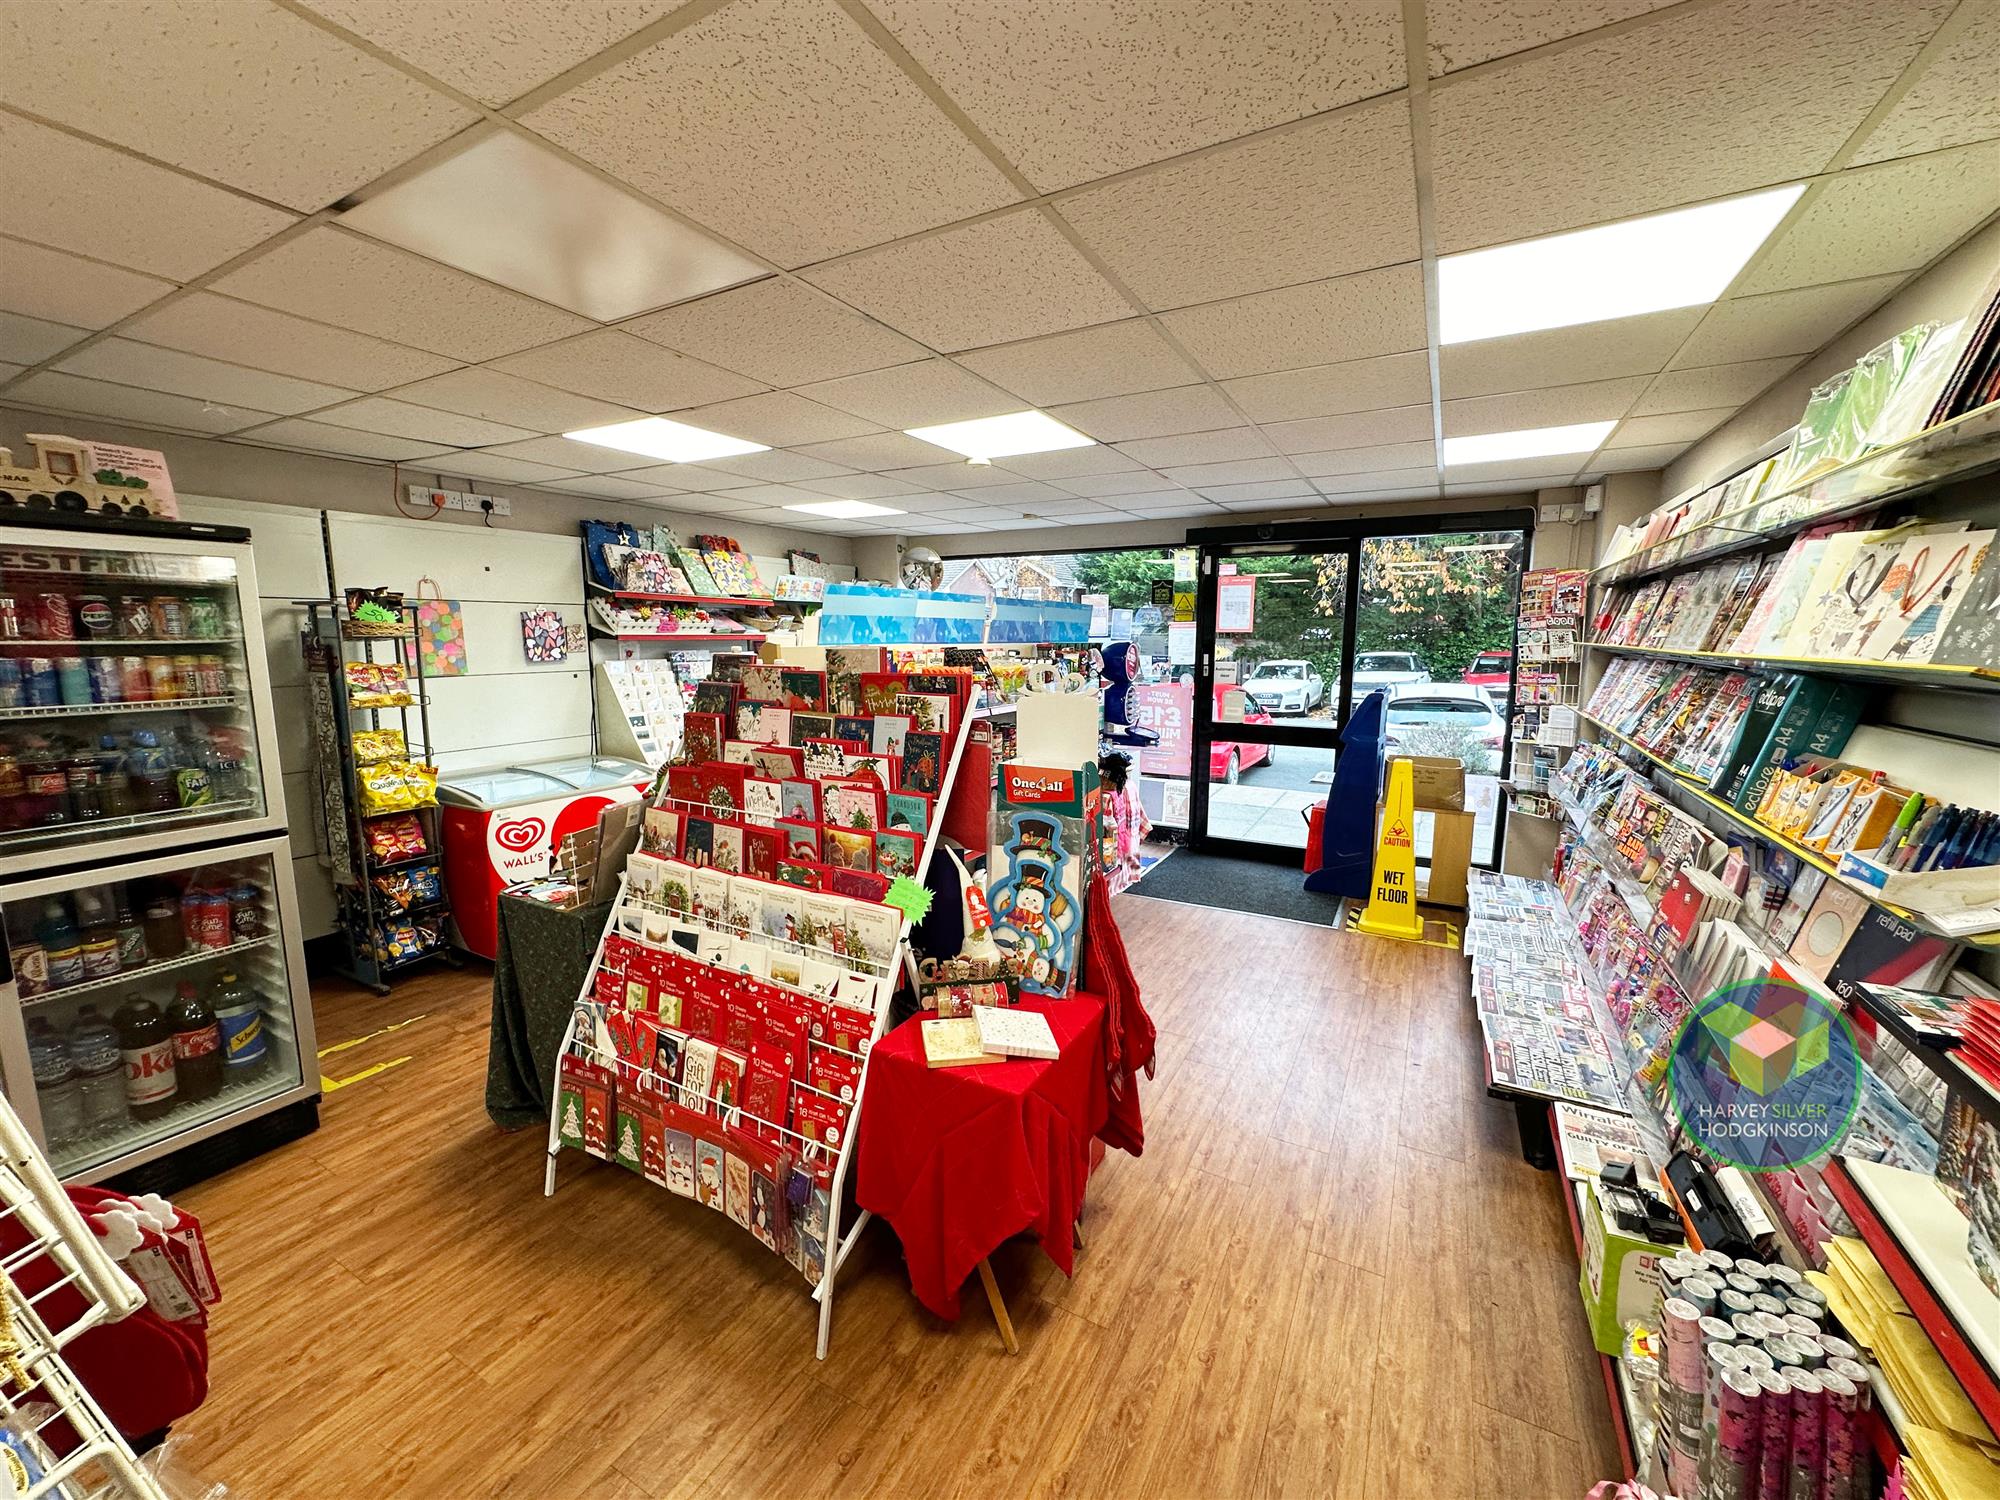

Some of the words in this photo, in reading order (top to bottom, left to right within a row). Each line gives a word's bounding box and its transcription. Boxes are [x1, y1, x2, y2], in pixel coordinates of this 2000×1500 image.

[1775, 727, 1795, 747] A4
[1809, 733, 1830, 753] A4
[1012, 777, 1064, 792] One4all
[1384, 836, 1411, 848] CAUTION
[503, 851, 545, 869] WALL'S
[1383, 870, 1405, 886] WET
[1377, 887, 1408, 905] FLOOR
[1876, 913, 1899, 933] refill
[1893, 924, 1916, 943] pad
[693, 991, 700, 999] 10
[1834, 979, 1853, 999] 160
[727, 1004, 734, 1012] 10
[765, 1018, 772, 1027] 10
[686, 1056, 706, 1075] Gift
[752, 1057, 760, 1066] 10
[1567, 1132, 1608, 1147] GUILTY
